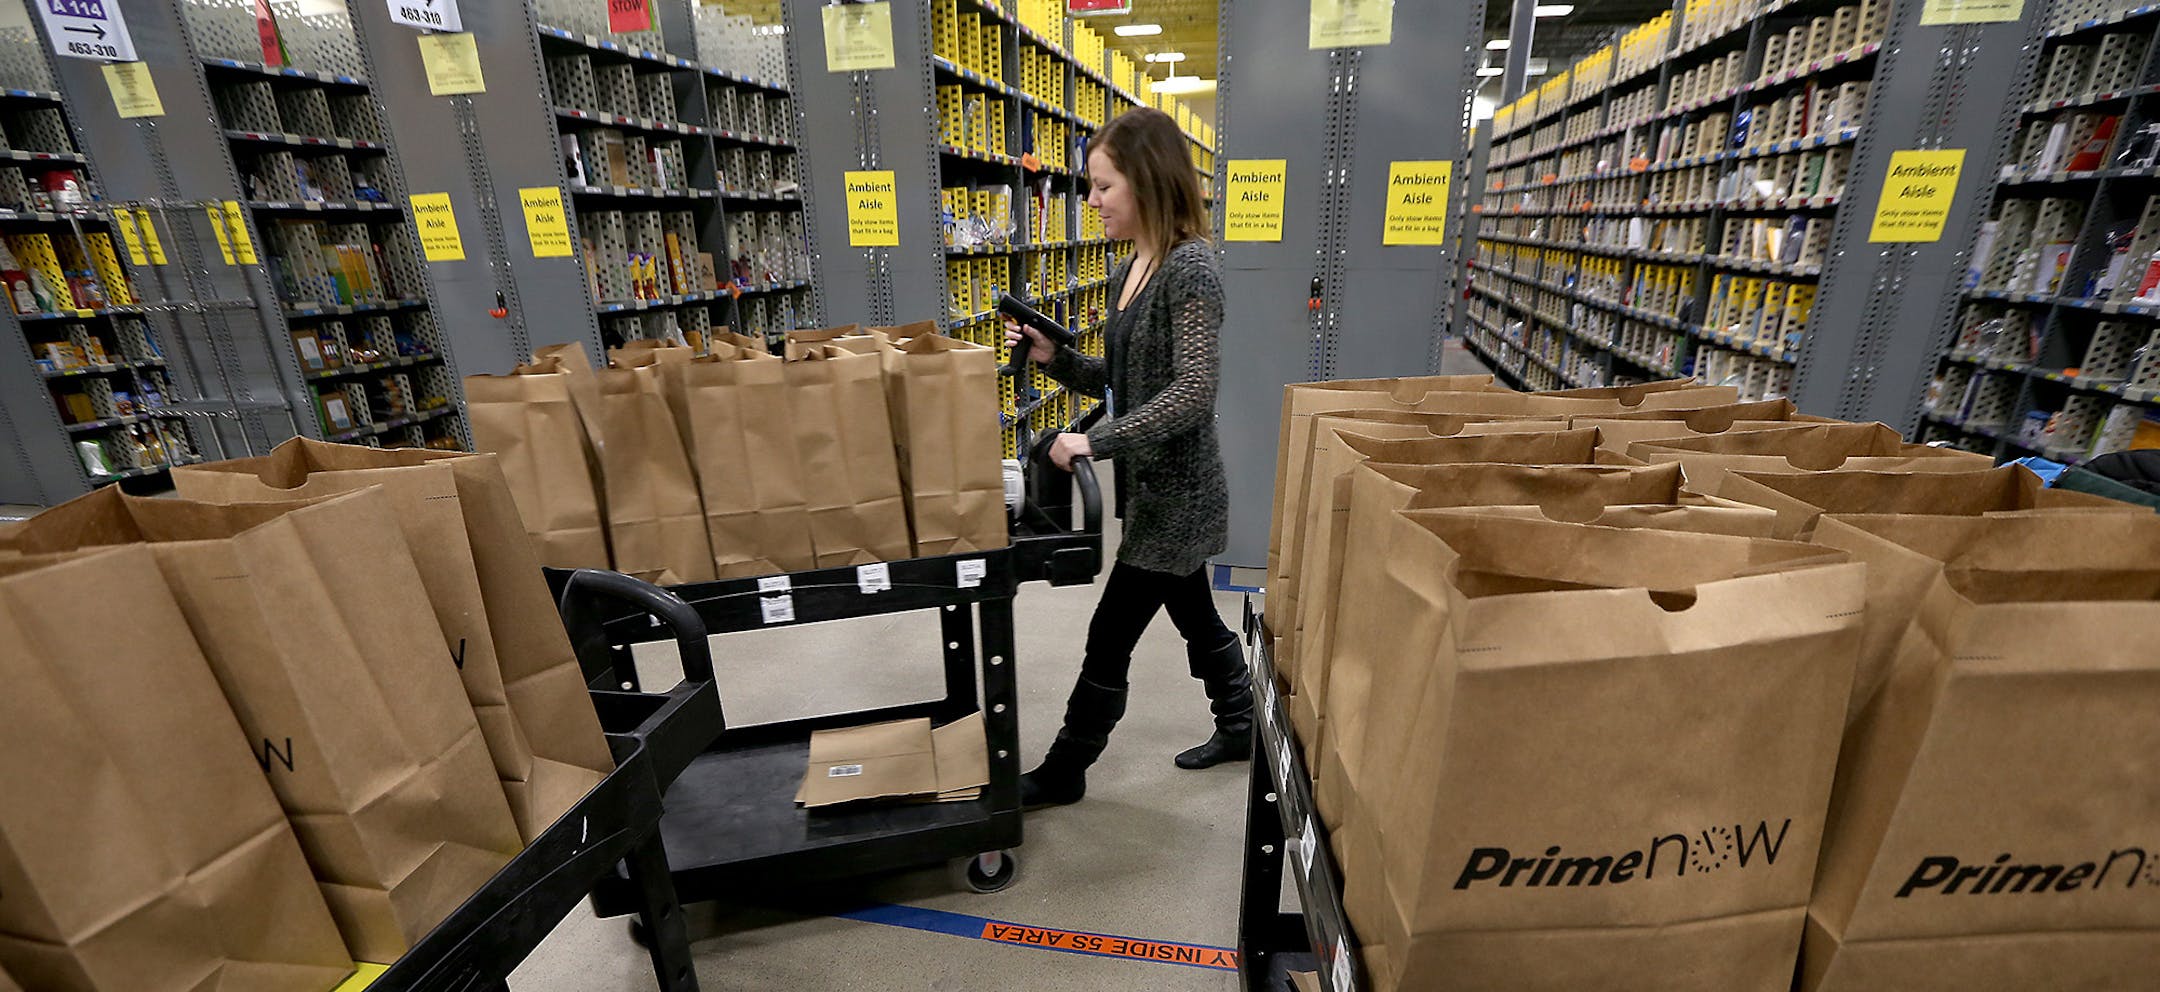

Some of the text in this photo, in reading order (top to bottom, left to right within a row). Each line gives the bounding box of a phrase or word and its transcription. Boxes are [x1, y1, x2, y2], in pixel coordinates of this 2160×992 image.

[53, 0, 102, 17] A 114
[612, 0, 641, 12] STOW
[400, 7, 442, 25] 463-310
[68, 42, 117, 58] 463-310
[1891, 163, 1958, 177] Ambient
[1231, 172, 1282, 183] Ambient
[1393, 173, 1446, 184] Ambient
[848, 182, 891, 192] Ambient
[1898, 185, 1937, 199] Aisle
[1241, 191, 1269, 201] Aisle
[1402, 193, 1432, 204] Aisle
[415, 203, 449, 213] Ambient
[524, 198, 559, 207] Ambient
[859, 199, 883, 209] Aisle
[426, 219, 445, 228] Aisle
[536, 214, 554, 222] Aisle
[992, 924, 1065, 946] AREA
[1072, 934, 1104, 951] 5S
[1111, 940, 1200, 964] INSIDE
